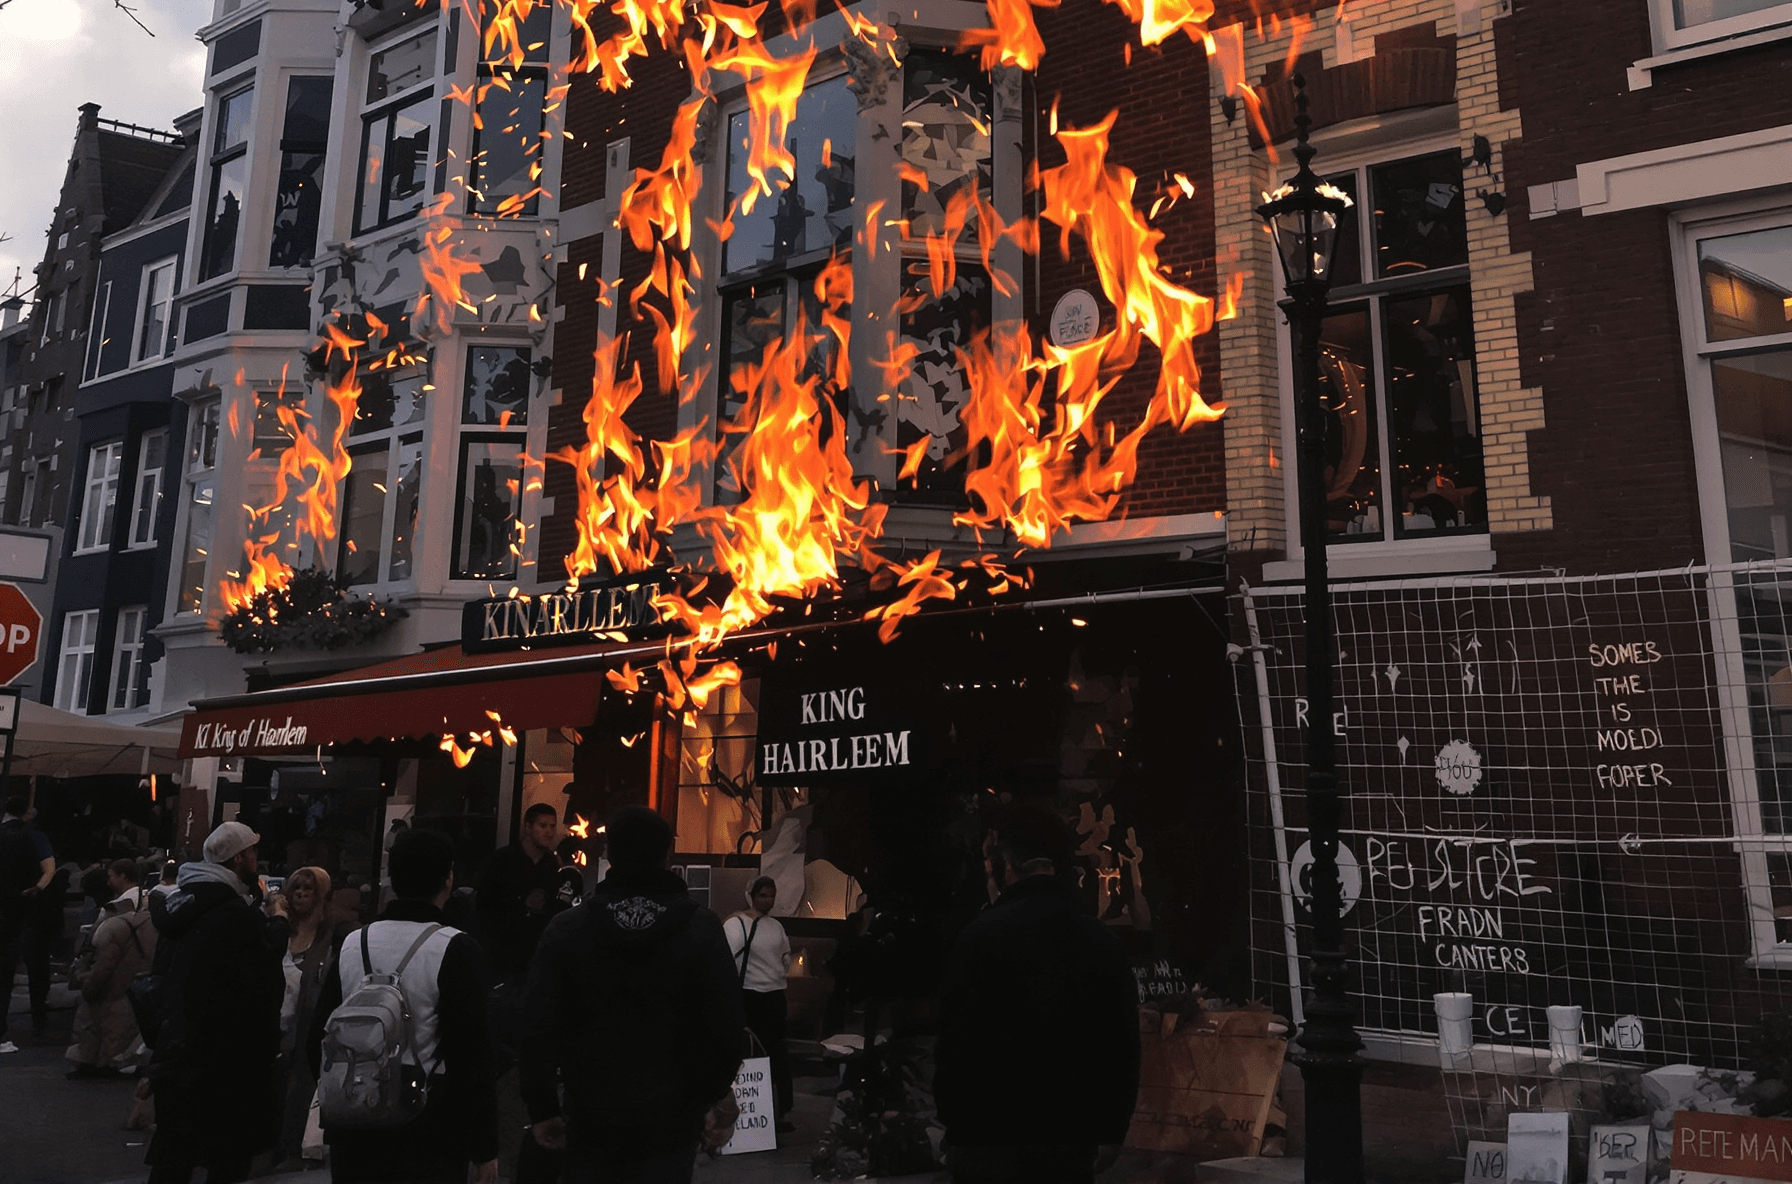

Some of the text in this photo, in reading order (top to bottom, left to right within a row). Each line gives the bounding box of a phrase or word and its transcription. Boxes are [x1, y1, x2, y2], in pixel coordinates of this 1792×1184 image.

[1596, 674, 1646, 696] THE
[800, 686, 866, 725] KING
[1611, 702, 1631, 722] IS
[238, 719, 255, 747] of
[762, 730, 911, 774] HAIRLEEM
[1435, 942, 1530, 974] CANTERS
